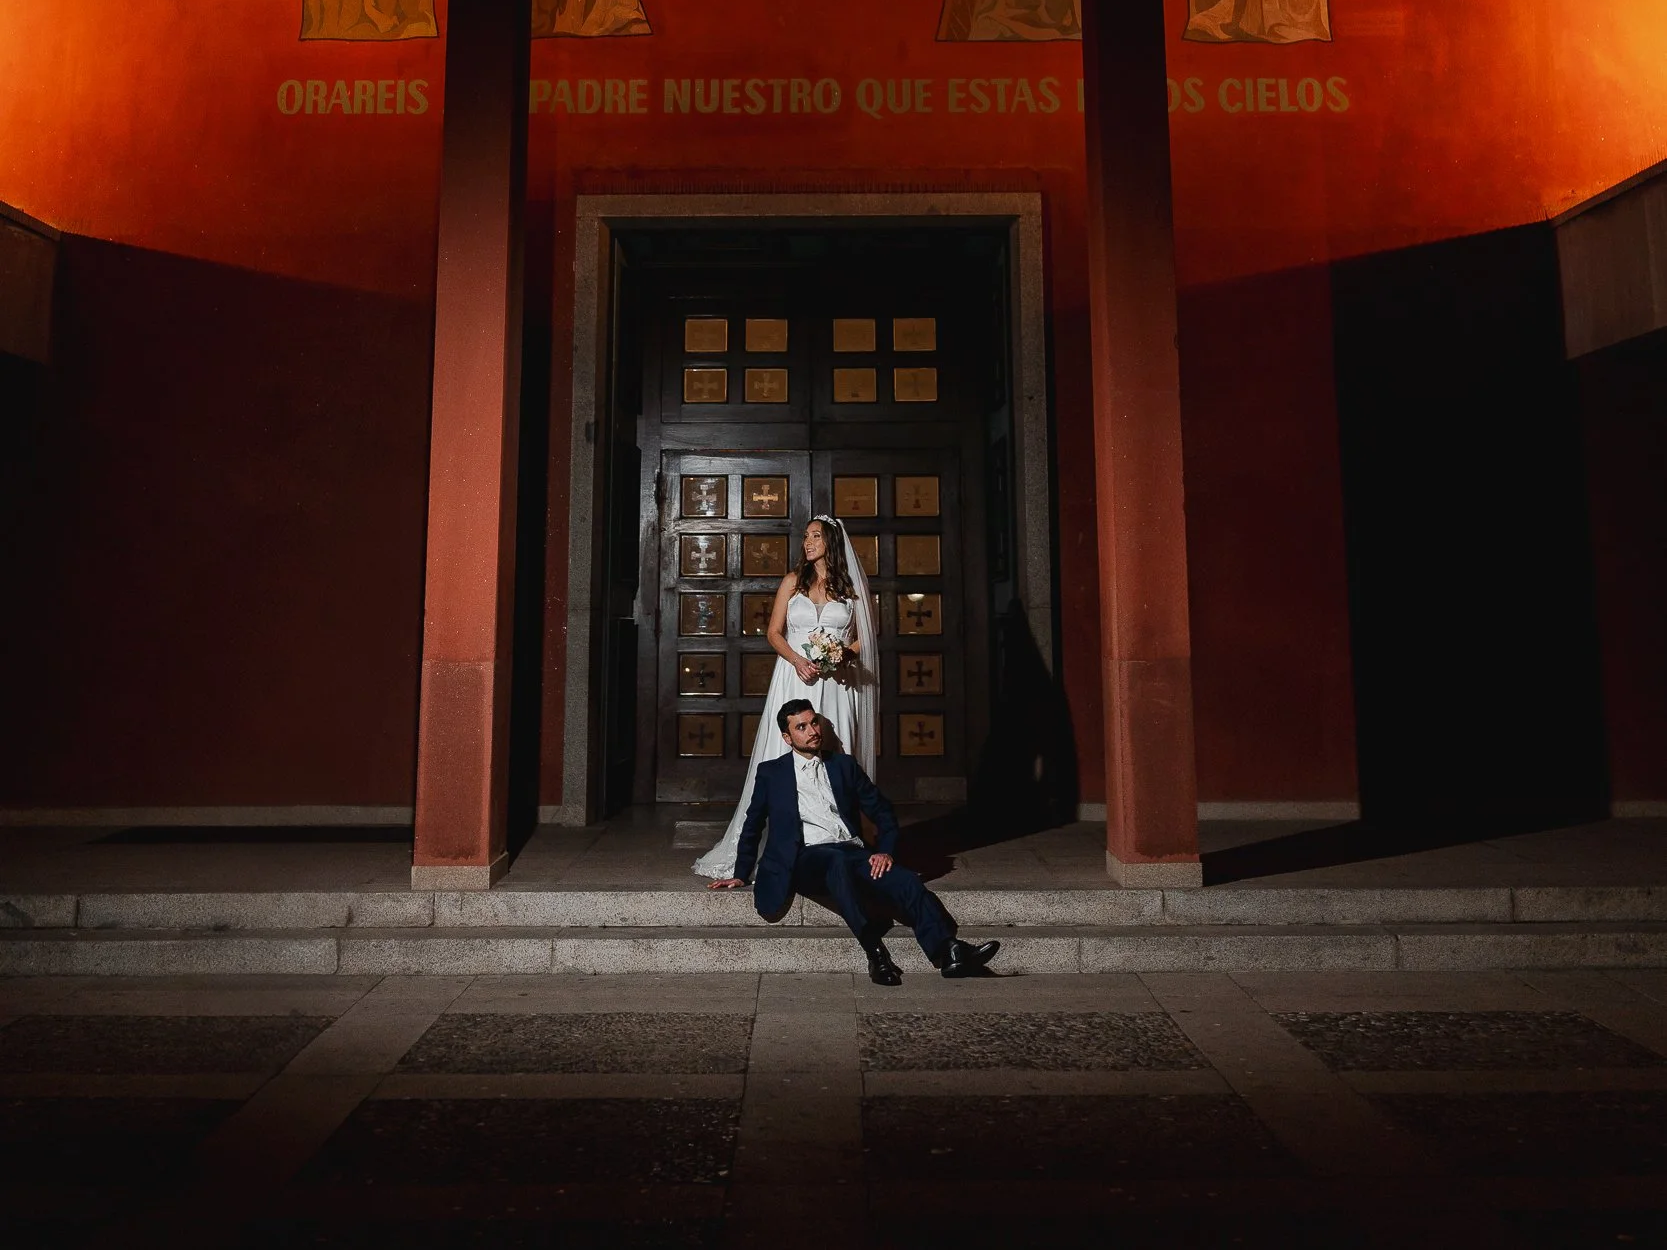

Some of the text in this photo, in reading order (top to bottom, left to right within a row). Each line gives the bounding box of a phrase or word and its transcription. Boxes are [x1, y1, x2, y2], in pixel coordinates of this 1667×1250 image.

[277, 79, 428, 115] ORAREIS
[528, 79, 649, 114] PADRE
[663, 78, 842, 114] NUESTRO
[855, 77, 933, 119] QUE
[947, 77, 1061, 114] ESTAS
[1217, 77, 1350, 113] CIELOS
